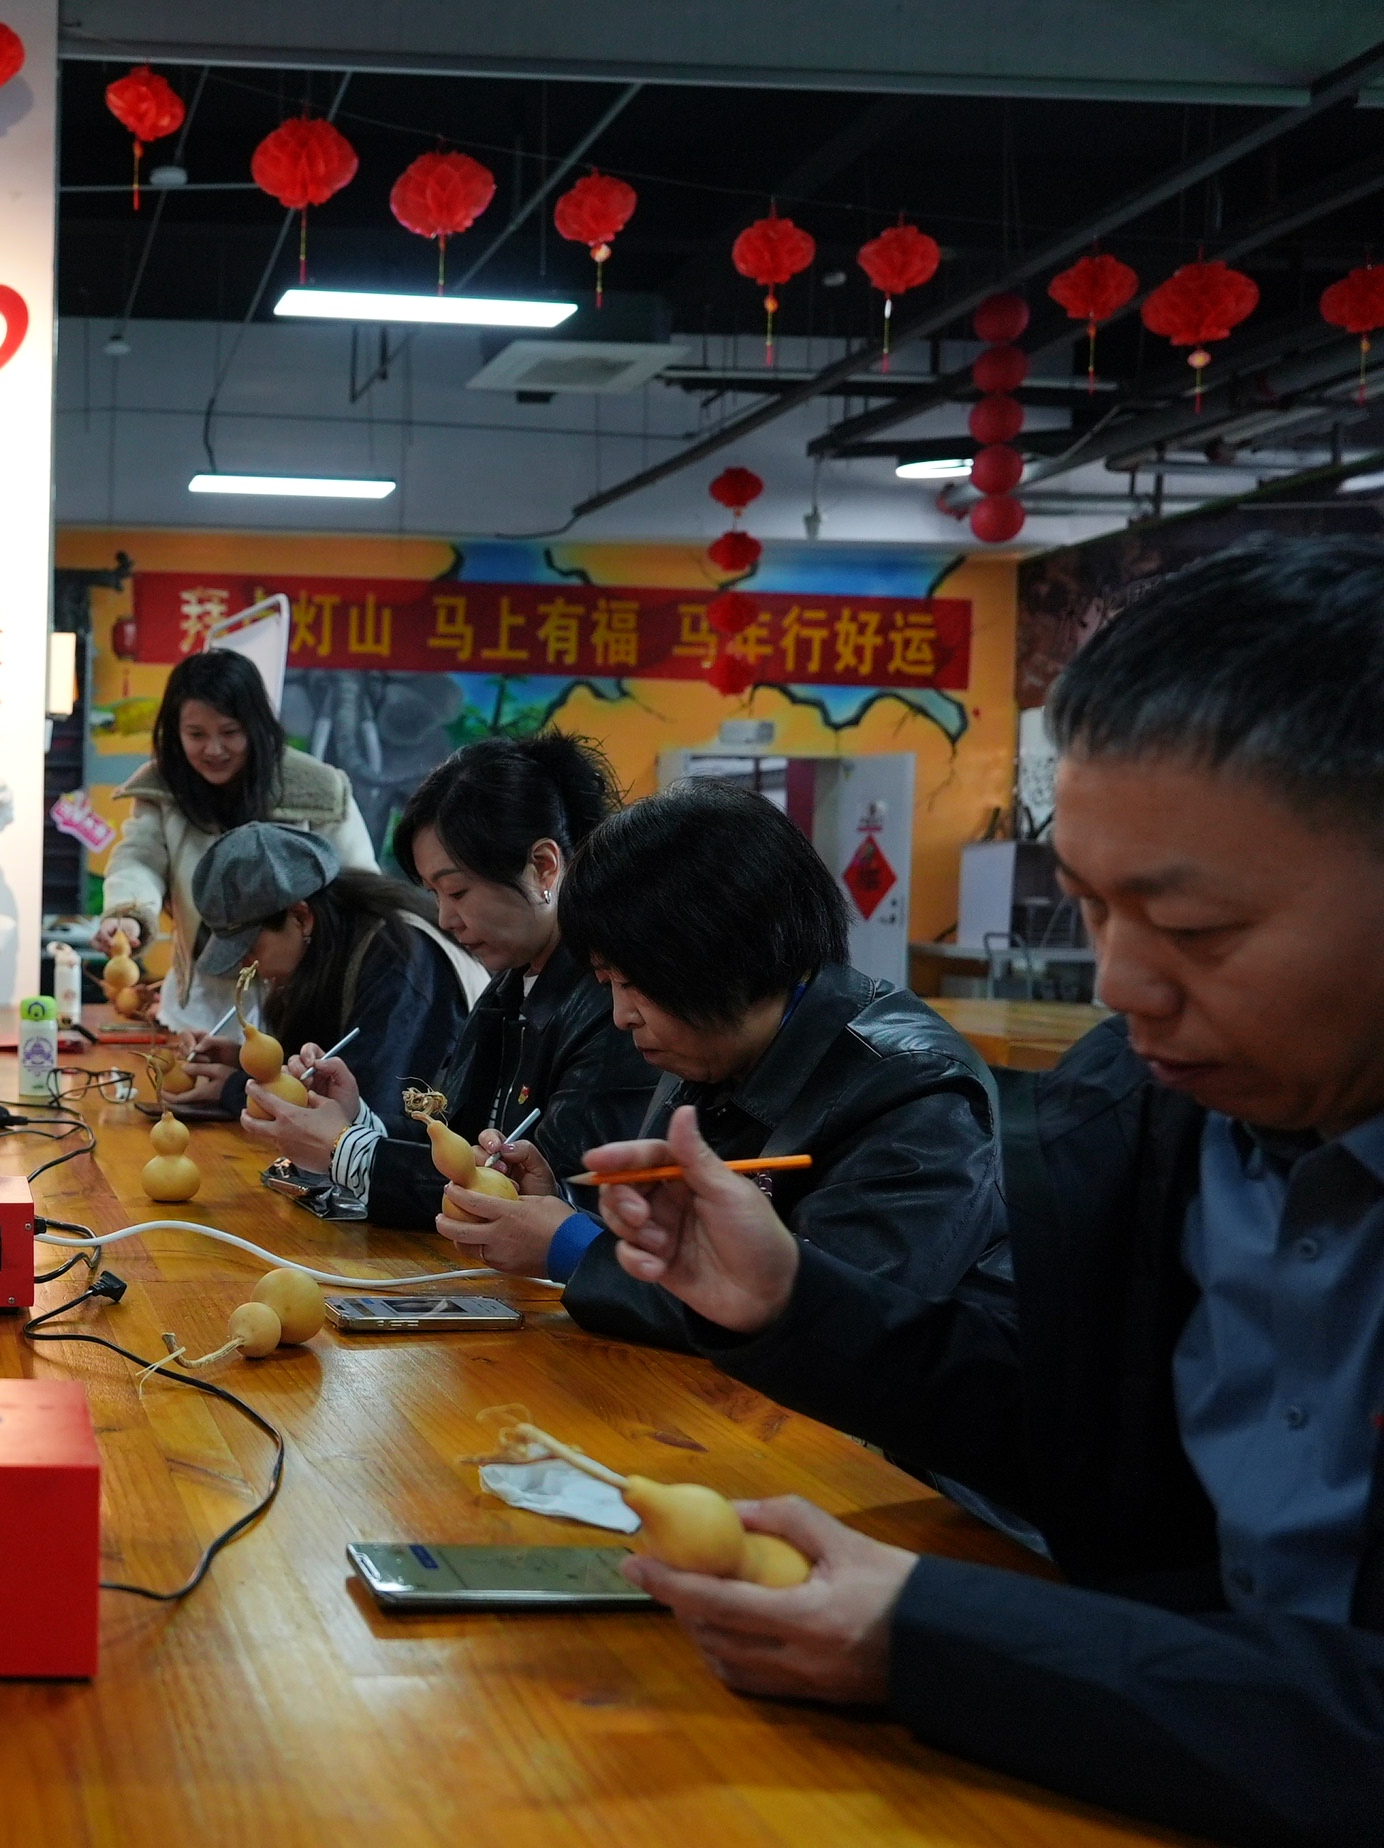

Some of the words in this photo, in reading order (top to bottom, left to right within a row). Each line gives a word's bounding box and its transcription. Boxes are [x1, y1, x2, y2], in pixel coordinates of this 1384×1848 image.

[178, 584, 393, 658] 拜灯山
[426, 595, 640, 667] 马上有福
[671, 603, 937, 676] 马年行好运
